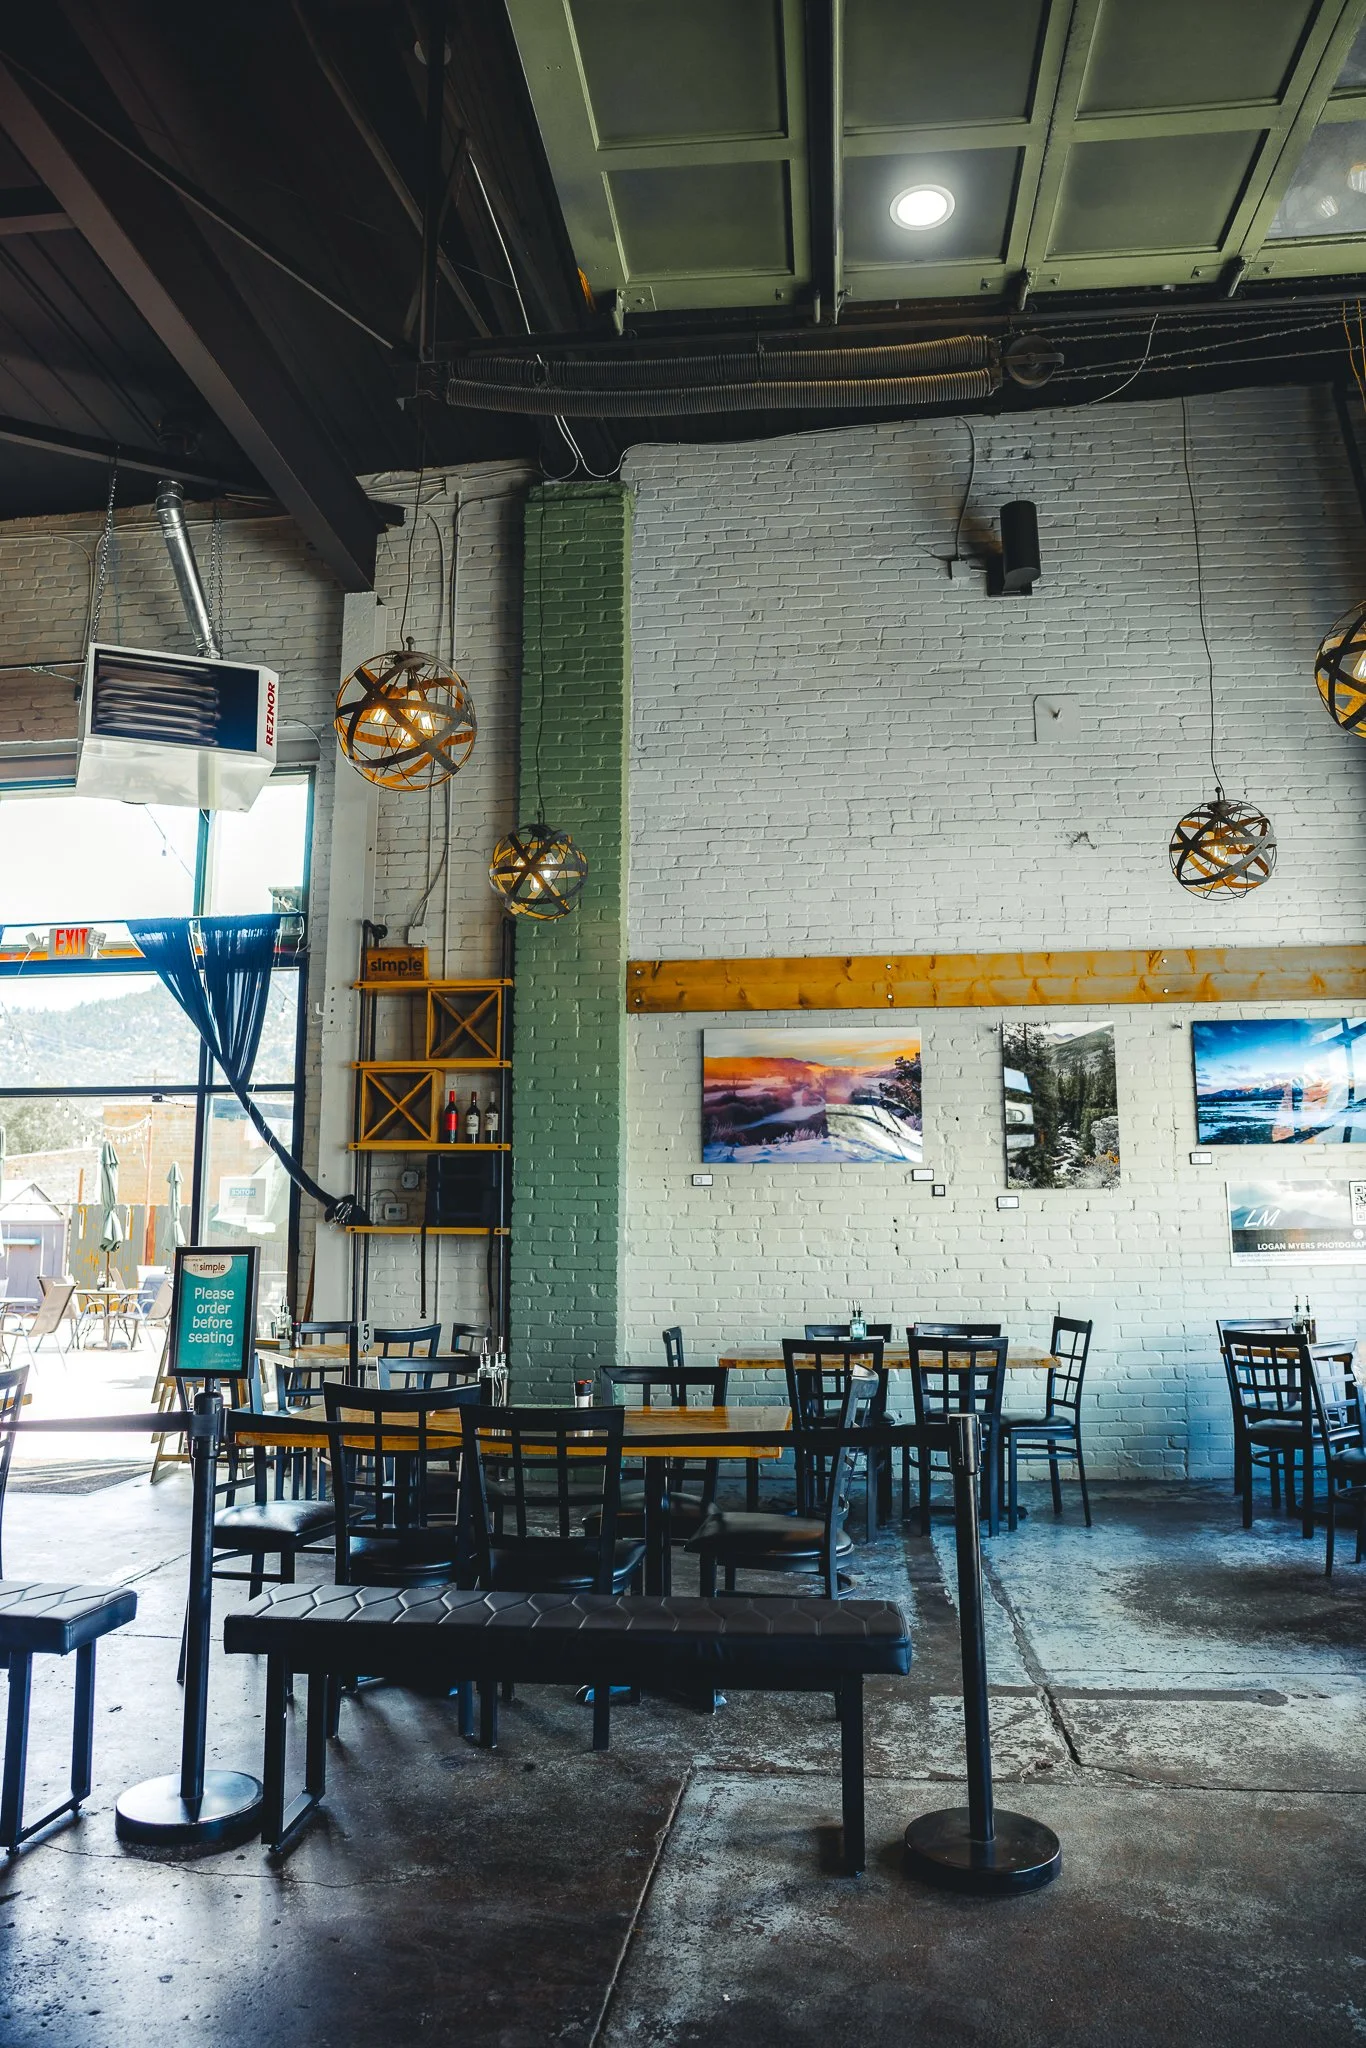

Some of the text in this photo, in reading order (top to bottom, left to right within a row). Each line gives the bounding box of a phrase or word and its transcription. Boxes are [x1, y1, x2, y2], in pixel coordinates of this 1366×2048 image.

[266, 682, 275, 746] REZNOR
[55, 929, 88, 956] EXIT
[371, 957, 422, 976] simple
[1244, 1209, 1280, 1227] LM
[1288, 1242, 1315, 1250] MYERS
[199, 1262, 225, 1274] simple
[194, 1287, 235, 1300] Please
[196, 1302, 231, 1314] order
[192, 1316, 233, 1329] before
[188, 1331, 234, 1347] seating
[363, 1324, 370, 1340] 5
